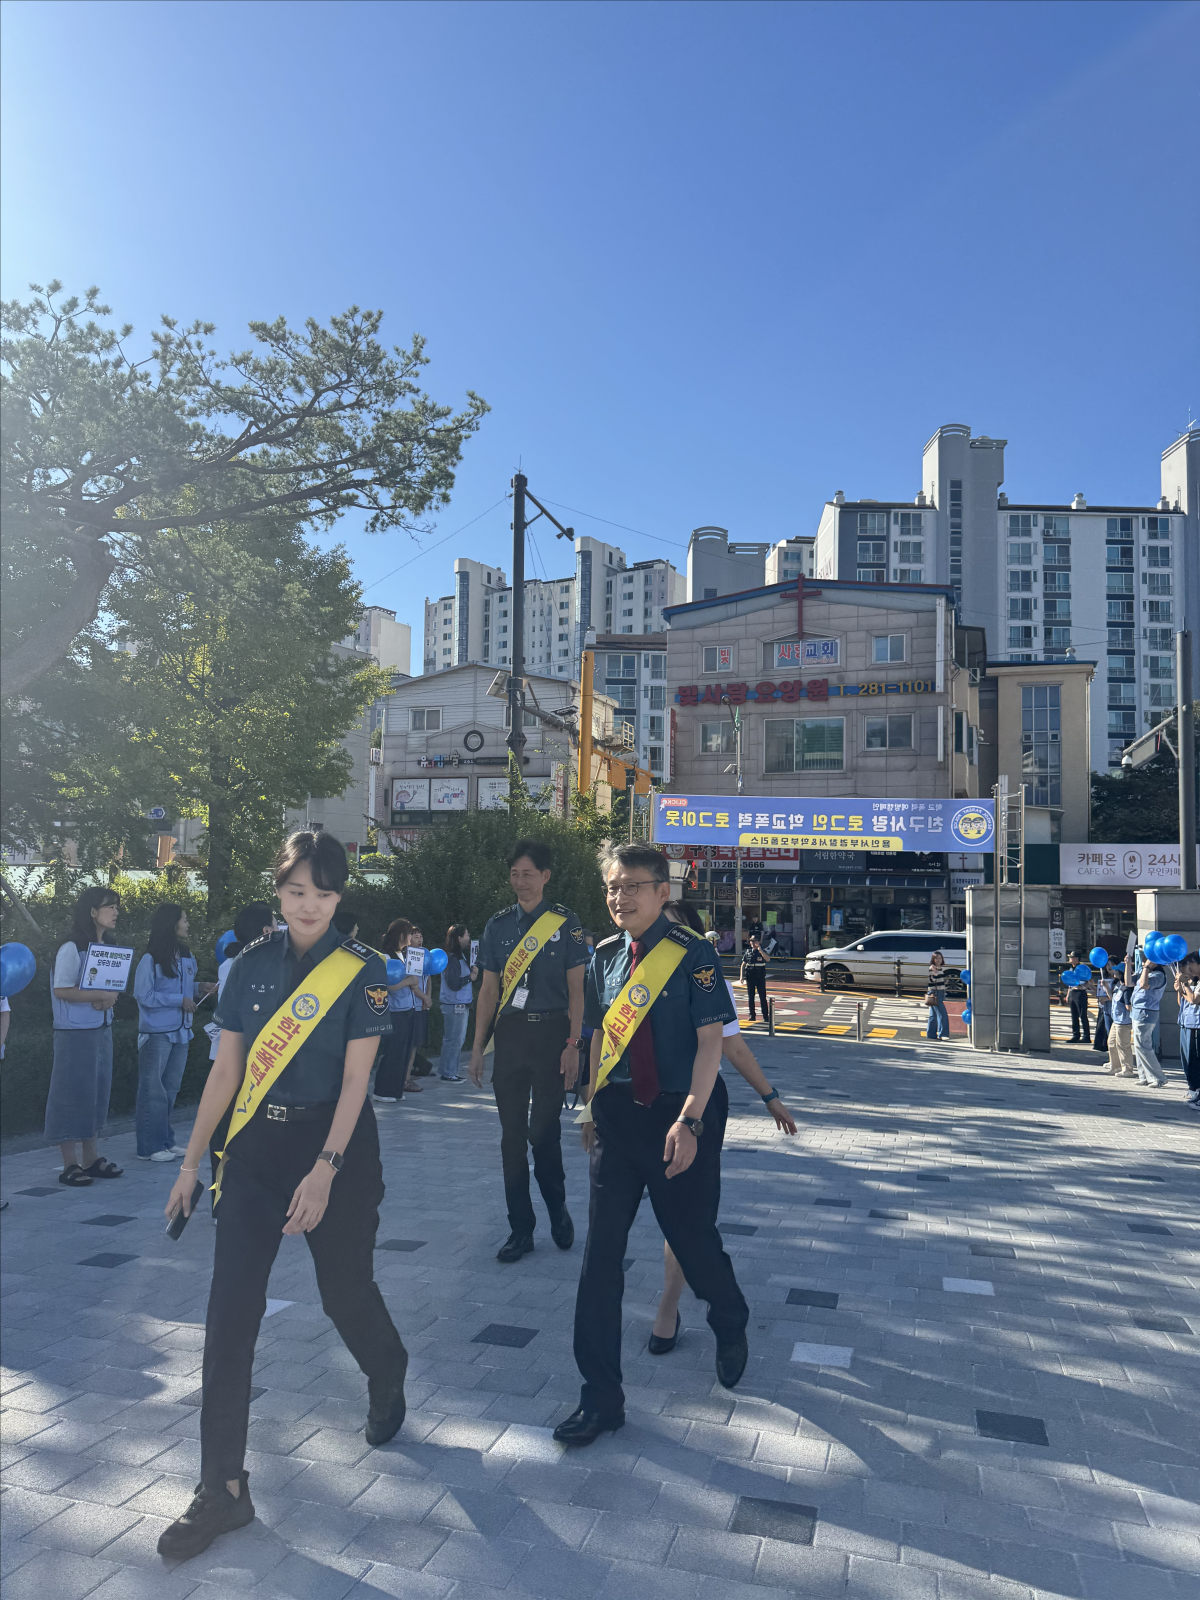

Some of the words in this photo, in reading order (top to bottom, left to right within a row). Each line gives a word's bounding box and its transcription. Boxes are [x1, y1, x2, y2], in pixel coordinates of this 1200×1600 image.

[720, 649, 729, 664] 빛
[678, 683, 749, 706] 빛사랑
[754, 679, 829, 704] 요양원
[858, 680, 932, 696] 281-1101
[814, 851, 856, 861] 서림한약국
[1077, 853, 1117, 866] 카페온
[1147, 853, 1181, 866] 24시
[249, 1016, 302, 1087] 학교폭력
